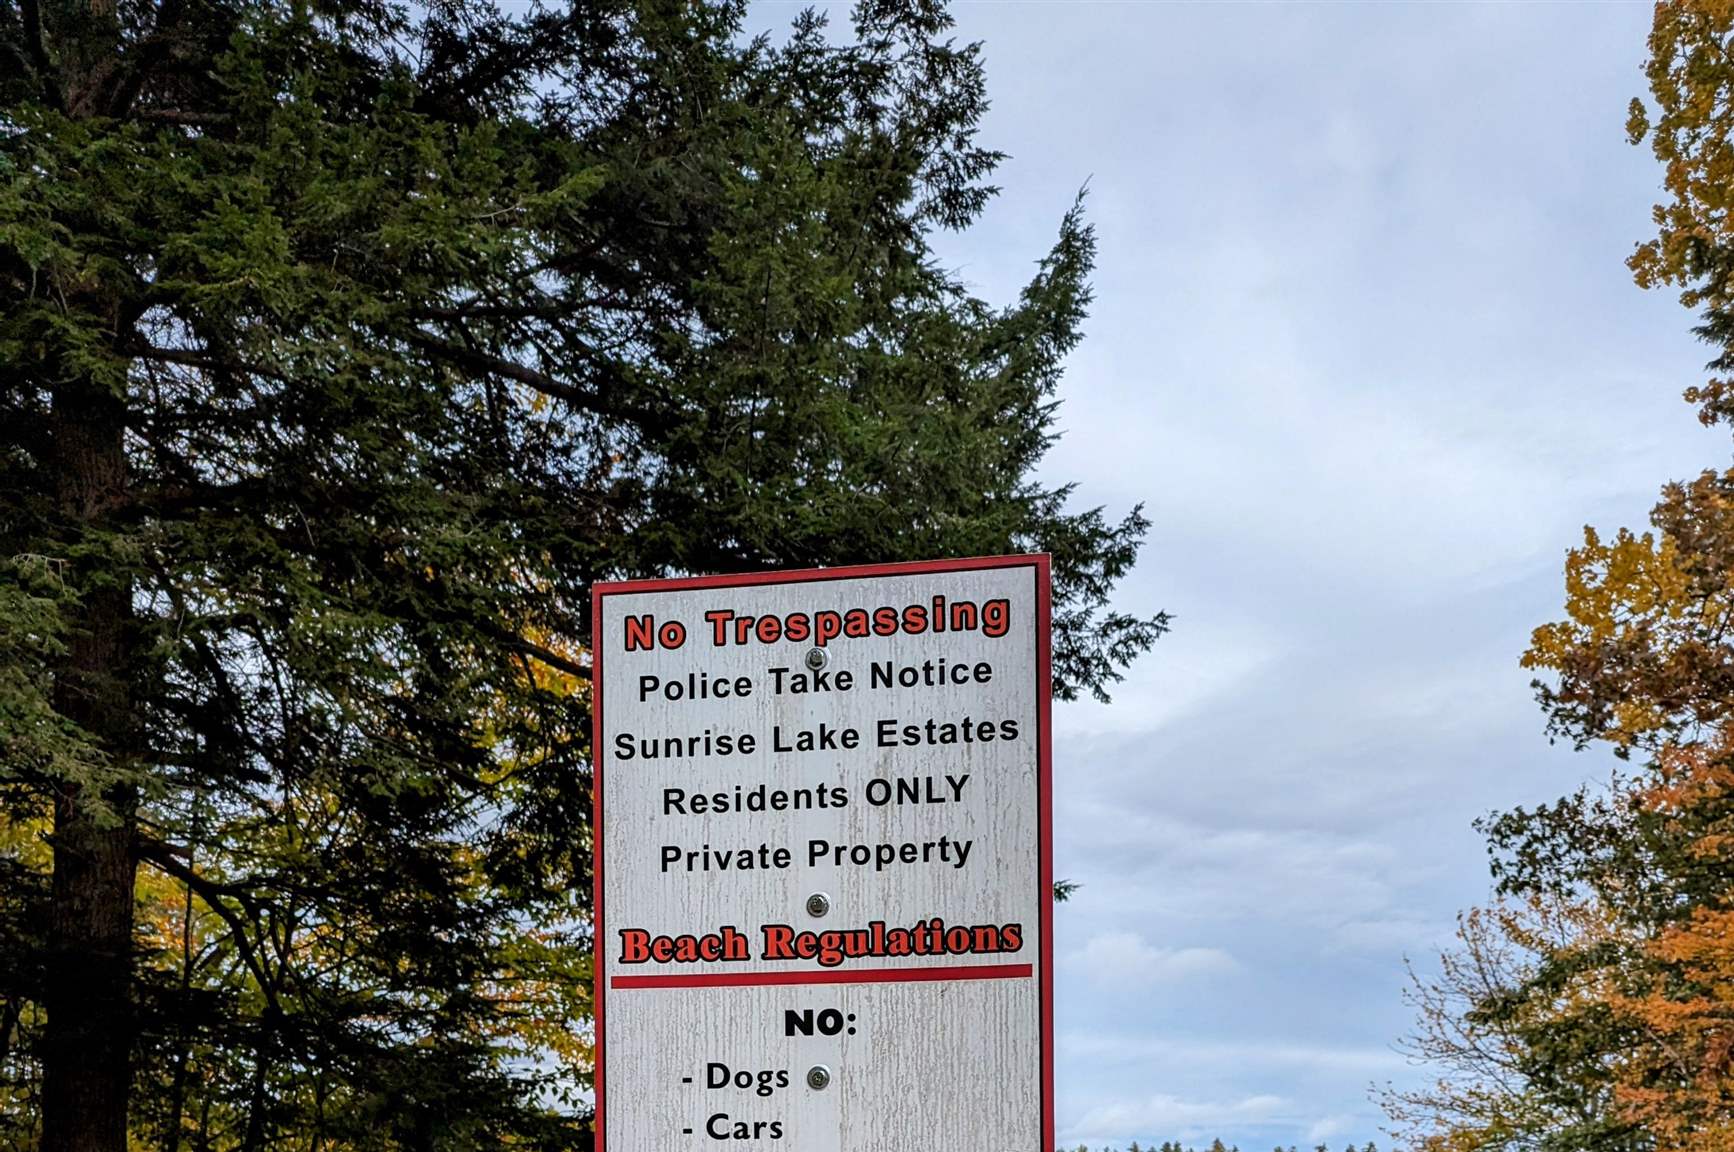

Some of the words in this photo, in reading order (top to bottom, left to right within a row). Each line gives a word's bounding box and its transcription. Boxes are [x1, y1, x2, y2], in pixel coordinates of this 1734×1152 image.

[624, 614, 687, 652] No
[705, 595, 1010, 647] Trespassing
[639, 672, 753, 703] Police
[768, 667, 853, 694] Take
[870, 657, 993, 690] Notice
[614, 729, 756, 761] Sunrise
[773, 723, 860, 753] Lake
[877, 716, 1019, 748] Estates
[663, 782, 849, 816] Residents
[865, 774, 971, 807] ONLY
[661, 843, 791, 873] Private
[808, 835, 973, 872] Property
[618, 925, 752, 965] Beach
[761, 918, 1023, 966] Regulations
[784, 1008, 857, 1037] NO:
[707, 1063, 789, 1095] Dogs
[706, 1113, 783, 1141] Cars
